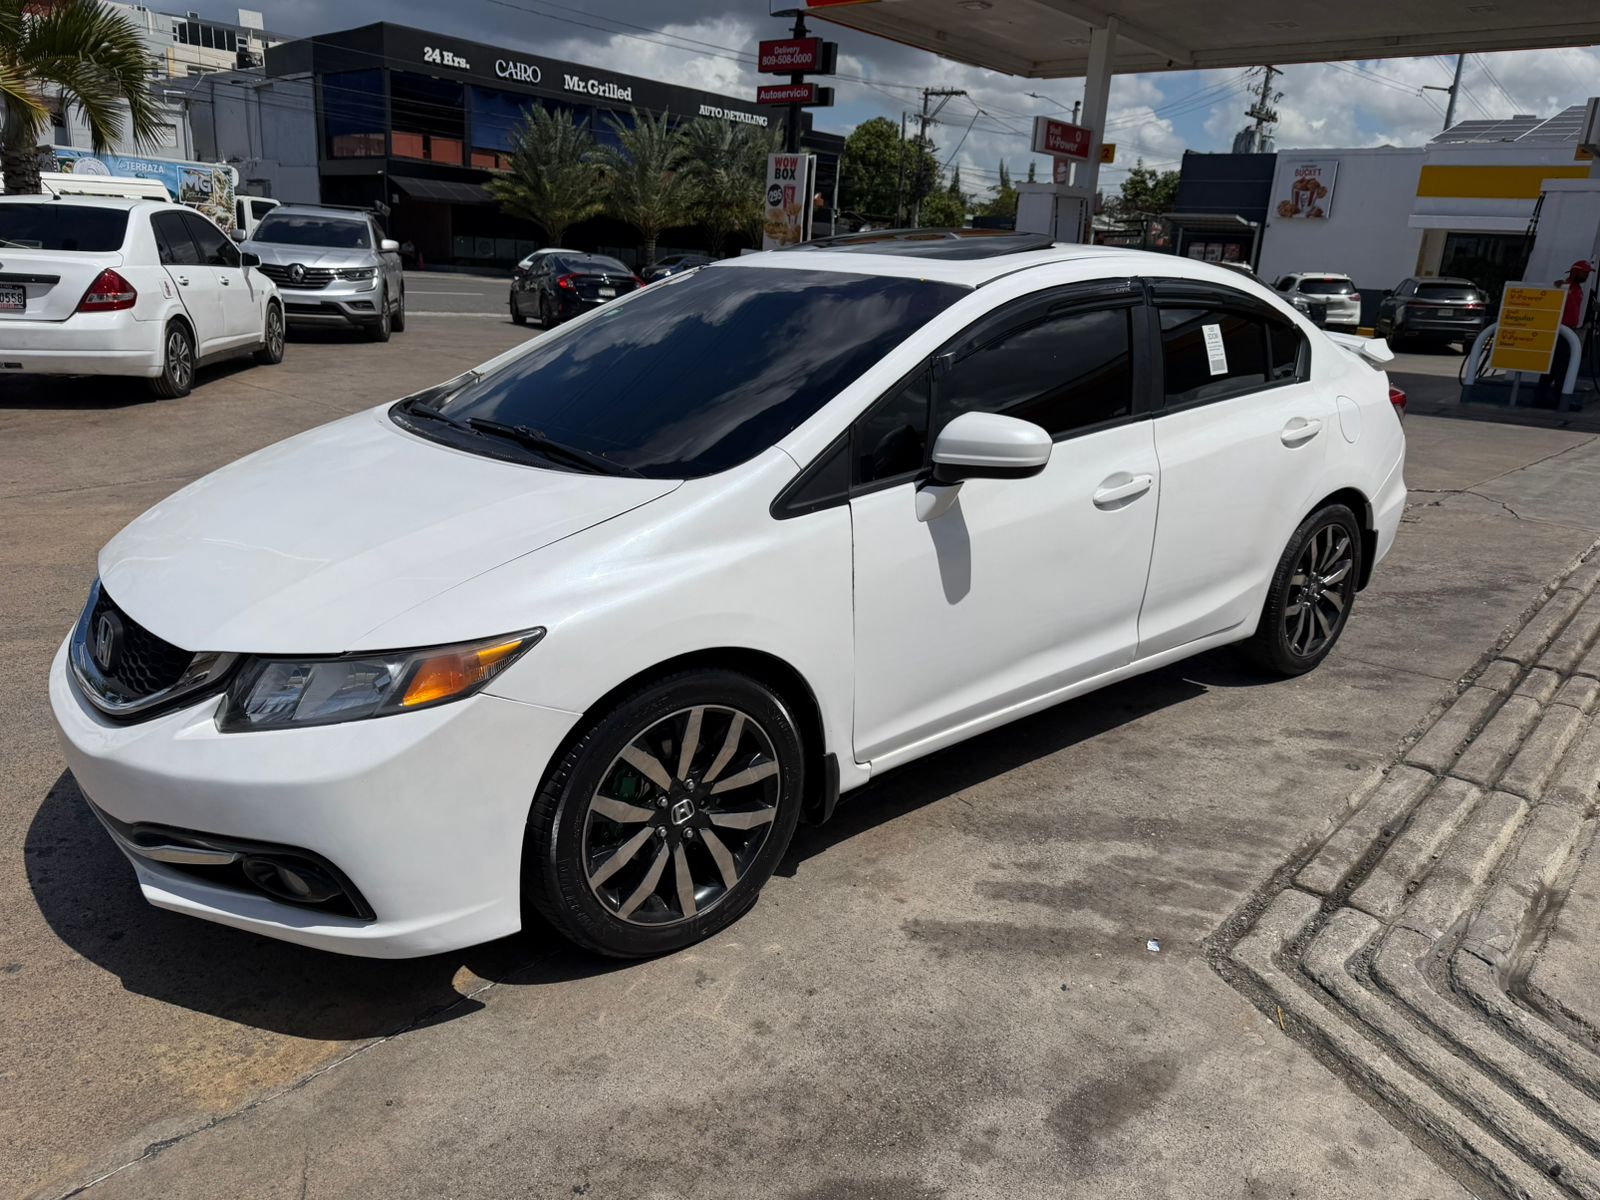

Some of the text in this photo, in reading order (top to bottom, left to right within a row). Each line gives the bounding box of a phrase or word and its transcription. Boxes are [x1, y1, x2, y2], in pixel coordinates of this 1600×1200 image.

[423, 46, 470, 69] 24 Hrs.
[774, 46, 800, 56] Delivery
[495, 59, 541, 83] CAIRO
[760, 87, 808, 100] Autoservicio
[699, 104, 768, 127] AUTO DETAILING
[125, 160, 165, 174] TERRAZA
[774, 157, 798, 168] WOW
[774, 168, 796, 180] BOX
[1295, 168, 1322, 177] BUCKET
[183, 174, 212, 193] MG
